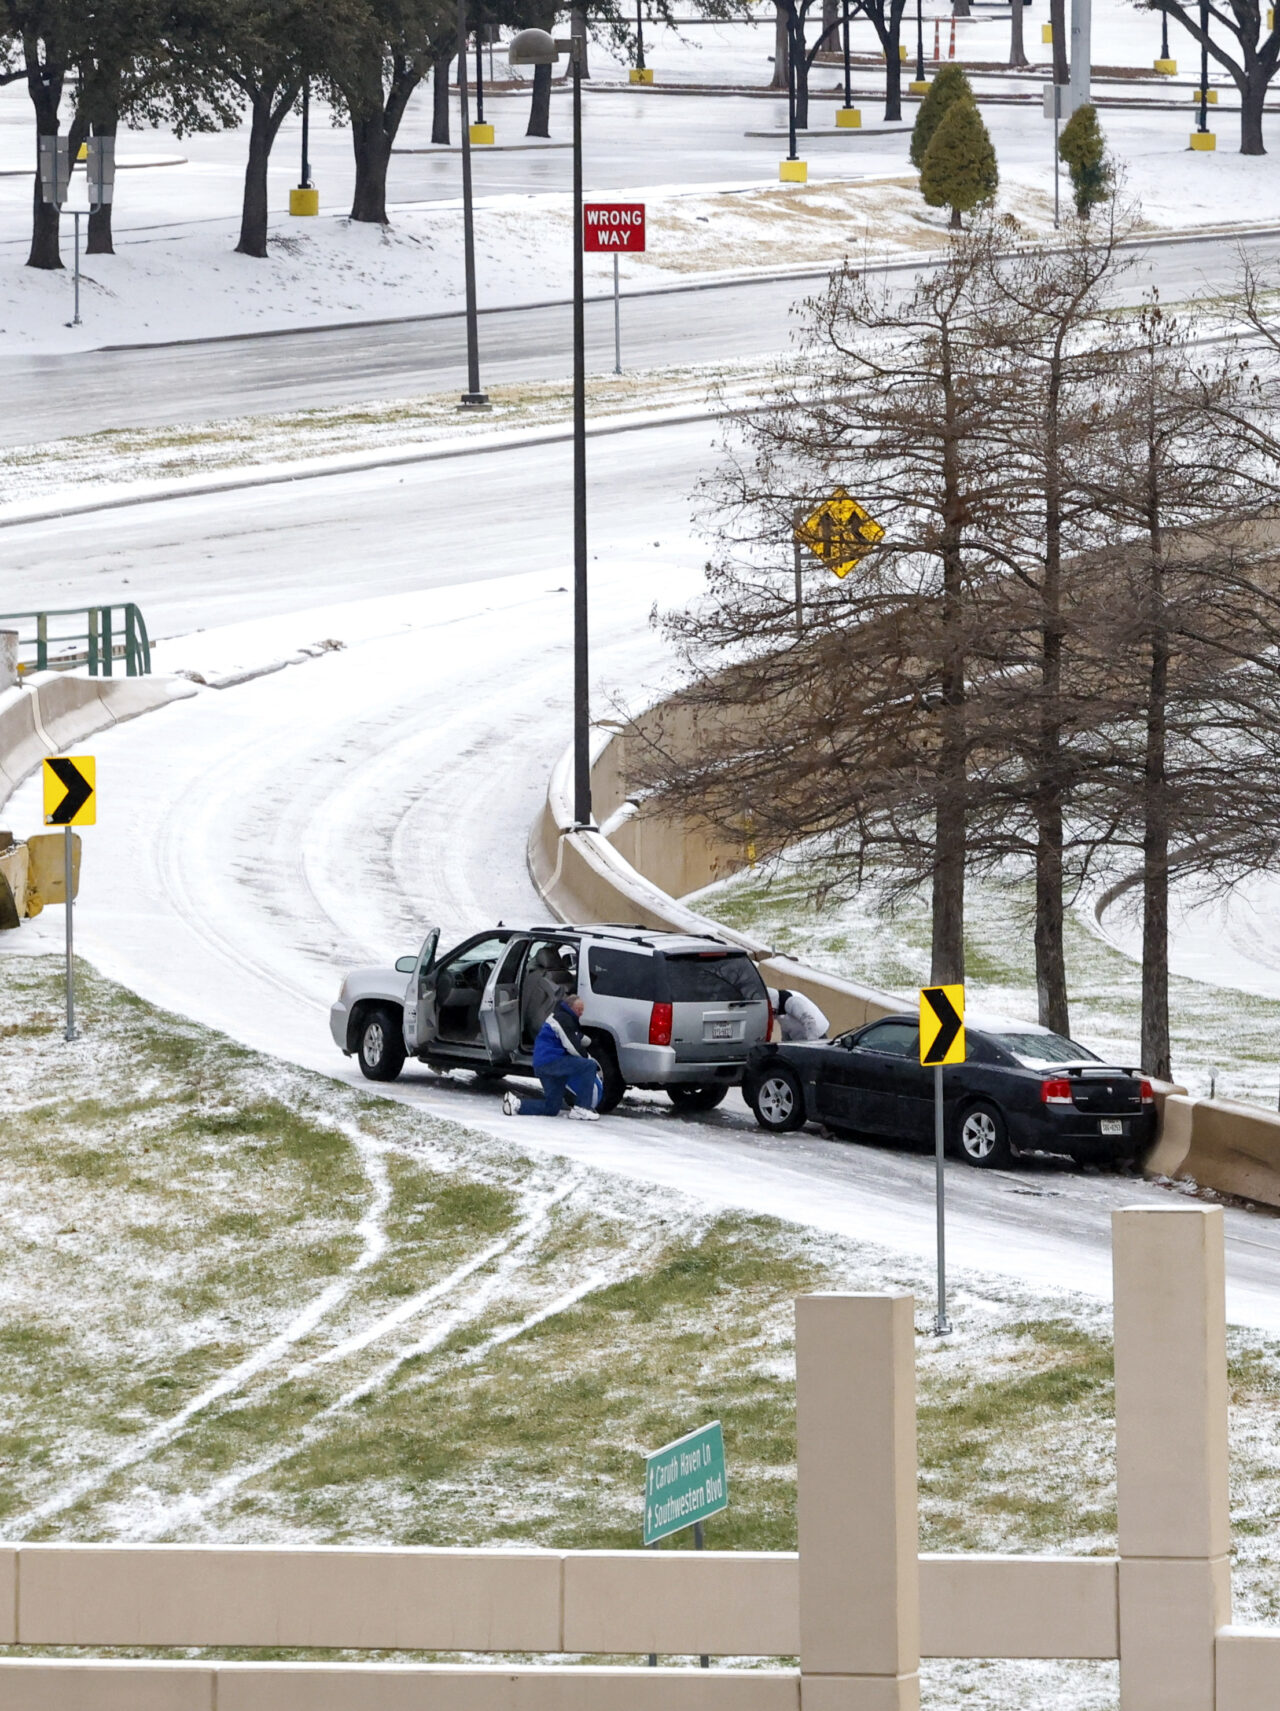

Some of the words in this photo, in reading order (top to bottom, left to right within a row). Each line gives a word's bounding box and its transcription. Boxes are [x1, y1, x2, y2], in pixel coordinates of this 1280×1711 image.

[587, 210, 642, 225] WRONG
[597, 230, 631, 245] WAY
[655, 1456, 679, 1489] Caruth
[680, 1449, 701, 1477] Haven
[702, 1443, 712, 1466] Ln
[654, 1487, 705, 1528] Southwestern
[705, 1472, 723, 1504] Blvd
